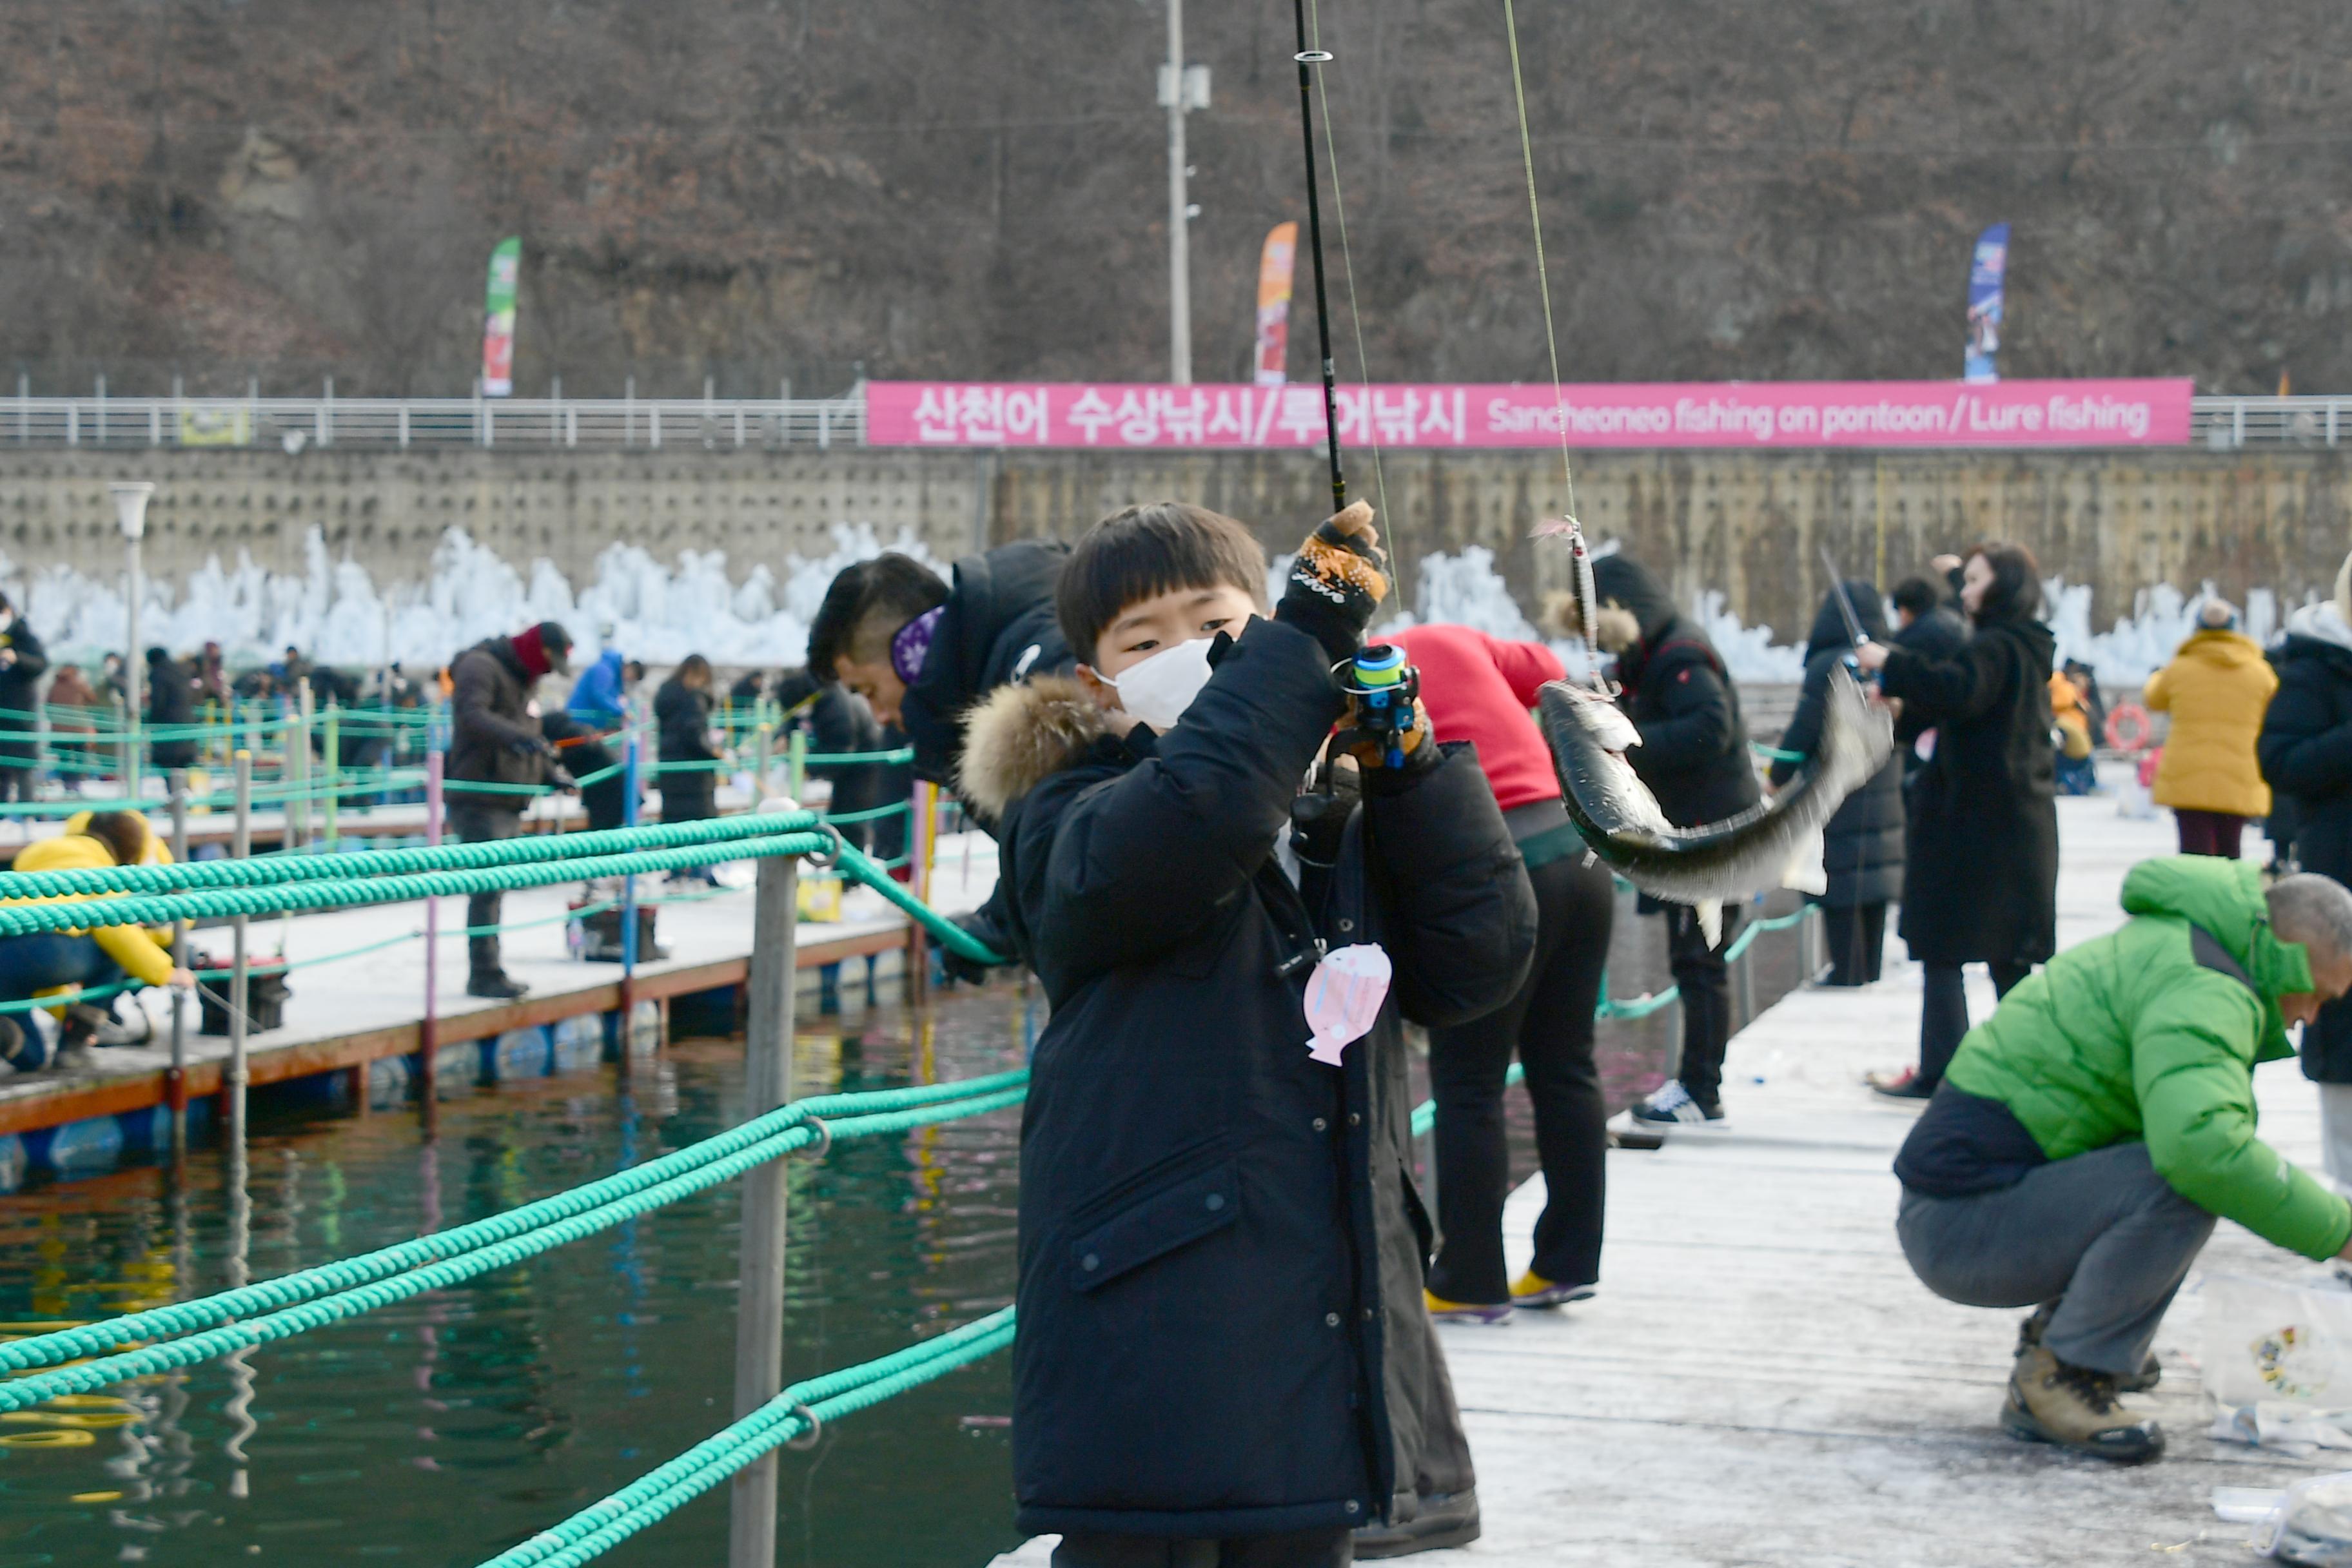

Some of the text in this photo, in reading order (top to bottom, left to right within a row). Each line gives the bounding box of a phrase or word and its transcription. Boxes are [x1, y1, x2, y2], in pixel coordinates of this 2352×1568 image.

[913, 387, 1049, 444] 산천어
[1487, 397, 1671, 433] Sancheoneo
[1675, 397, 1774, 441] fishing
[1778, 405, 1818, 433] on
[2048, 394, 2150, 439] fishing
